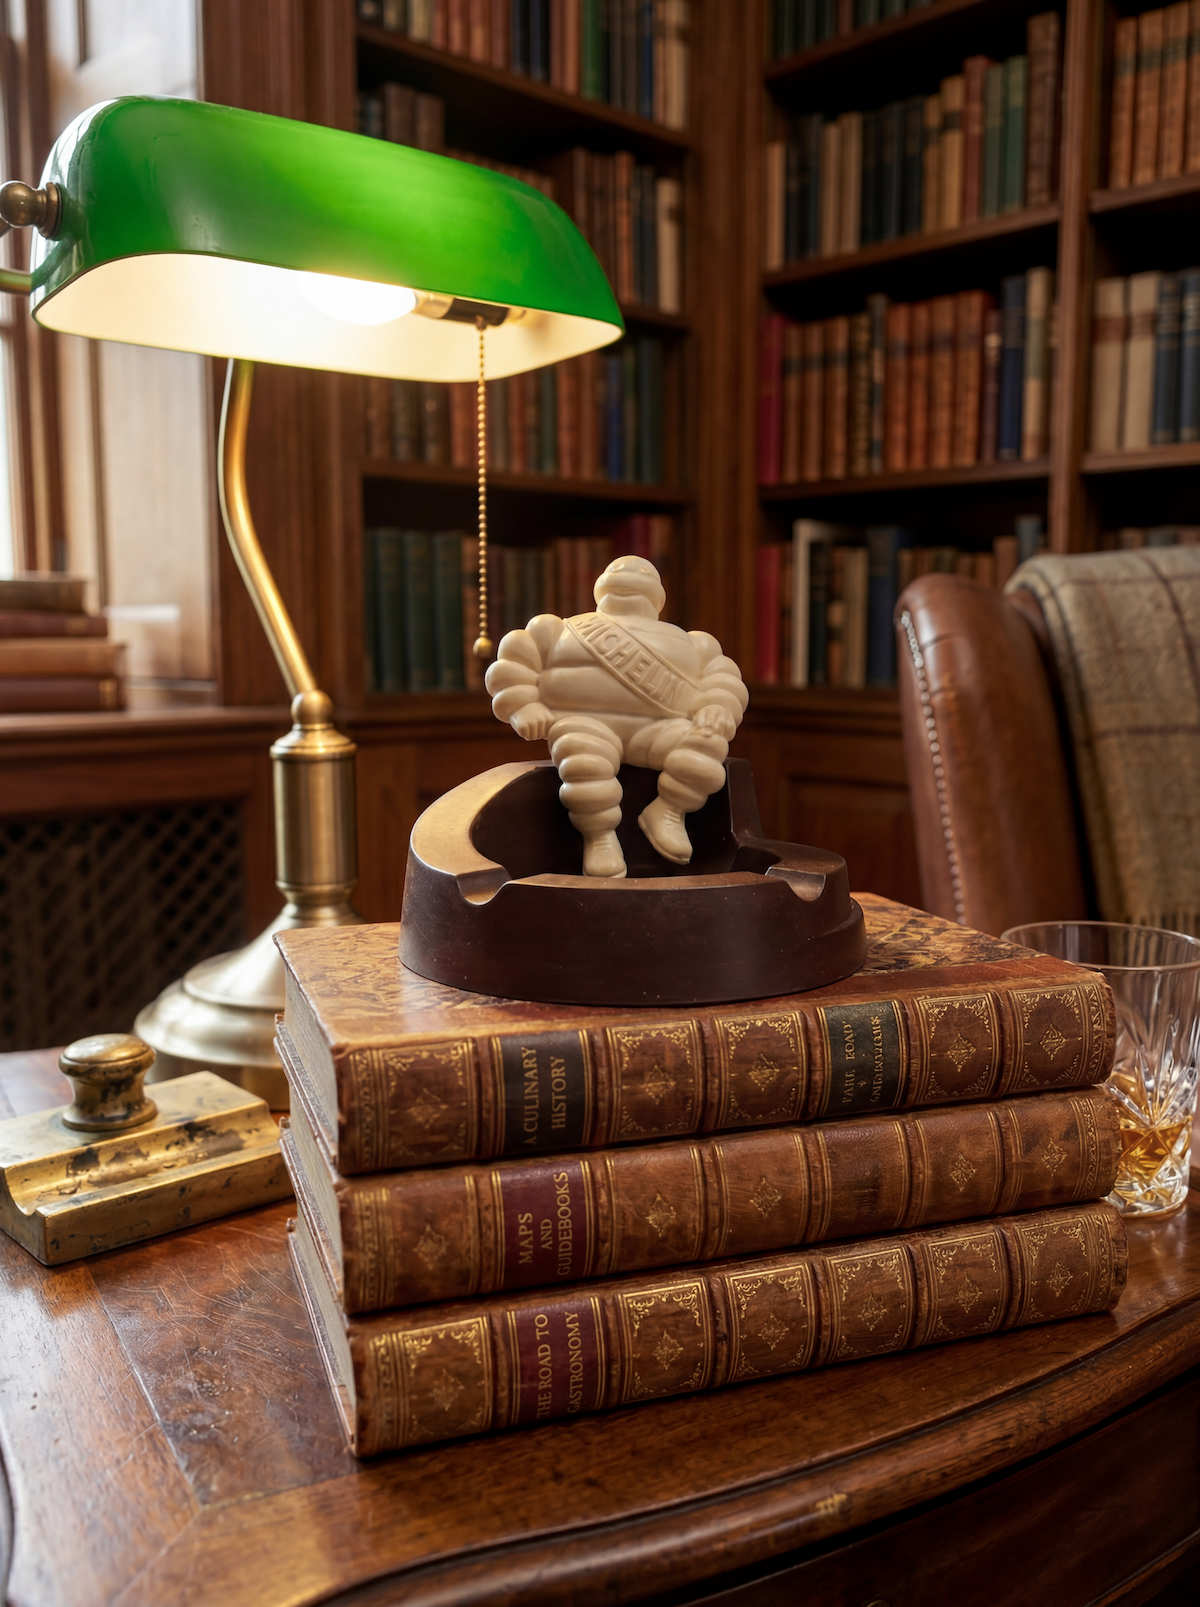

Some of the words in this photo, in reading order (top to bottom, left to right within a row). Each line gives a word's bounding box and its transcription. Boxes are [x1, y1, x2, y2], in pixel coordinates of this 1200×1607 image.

[575, 616, 684, 707] MICHELIN
[521, 1047, 539, 1133] CULINARY
[550, 1056, 567, 1129] HISTORY
[524, 1135, 537, 1145] A
[518, 1212, 533, 1264] MAPS
[541, 1218, 553, 1250] AND
[553, 1171, 573, 1275] GUIDEBOOKS
[534, 1313, 550, 1340] TO
[537, 1344, 552, 1390] ROAD
[564, 1311, 584, 1413] GASTRONOMY
[536, 1391, 552, 1418] THE
